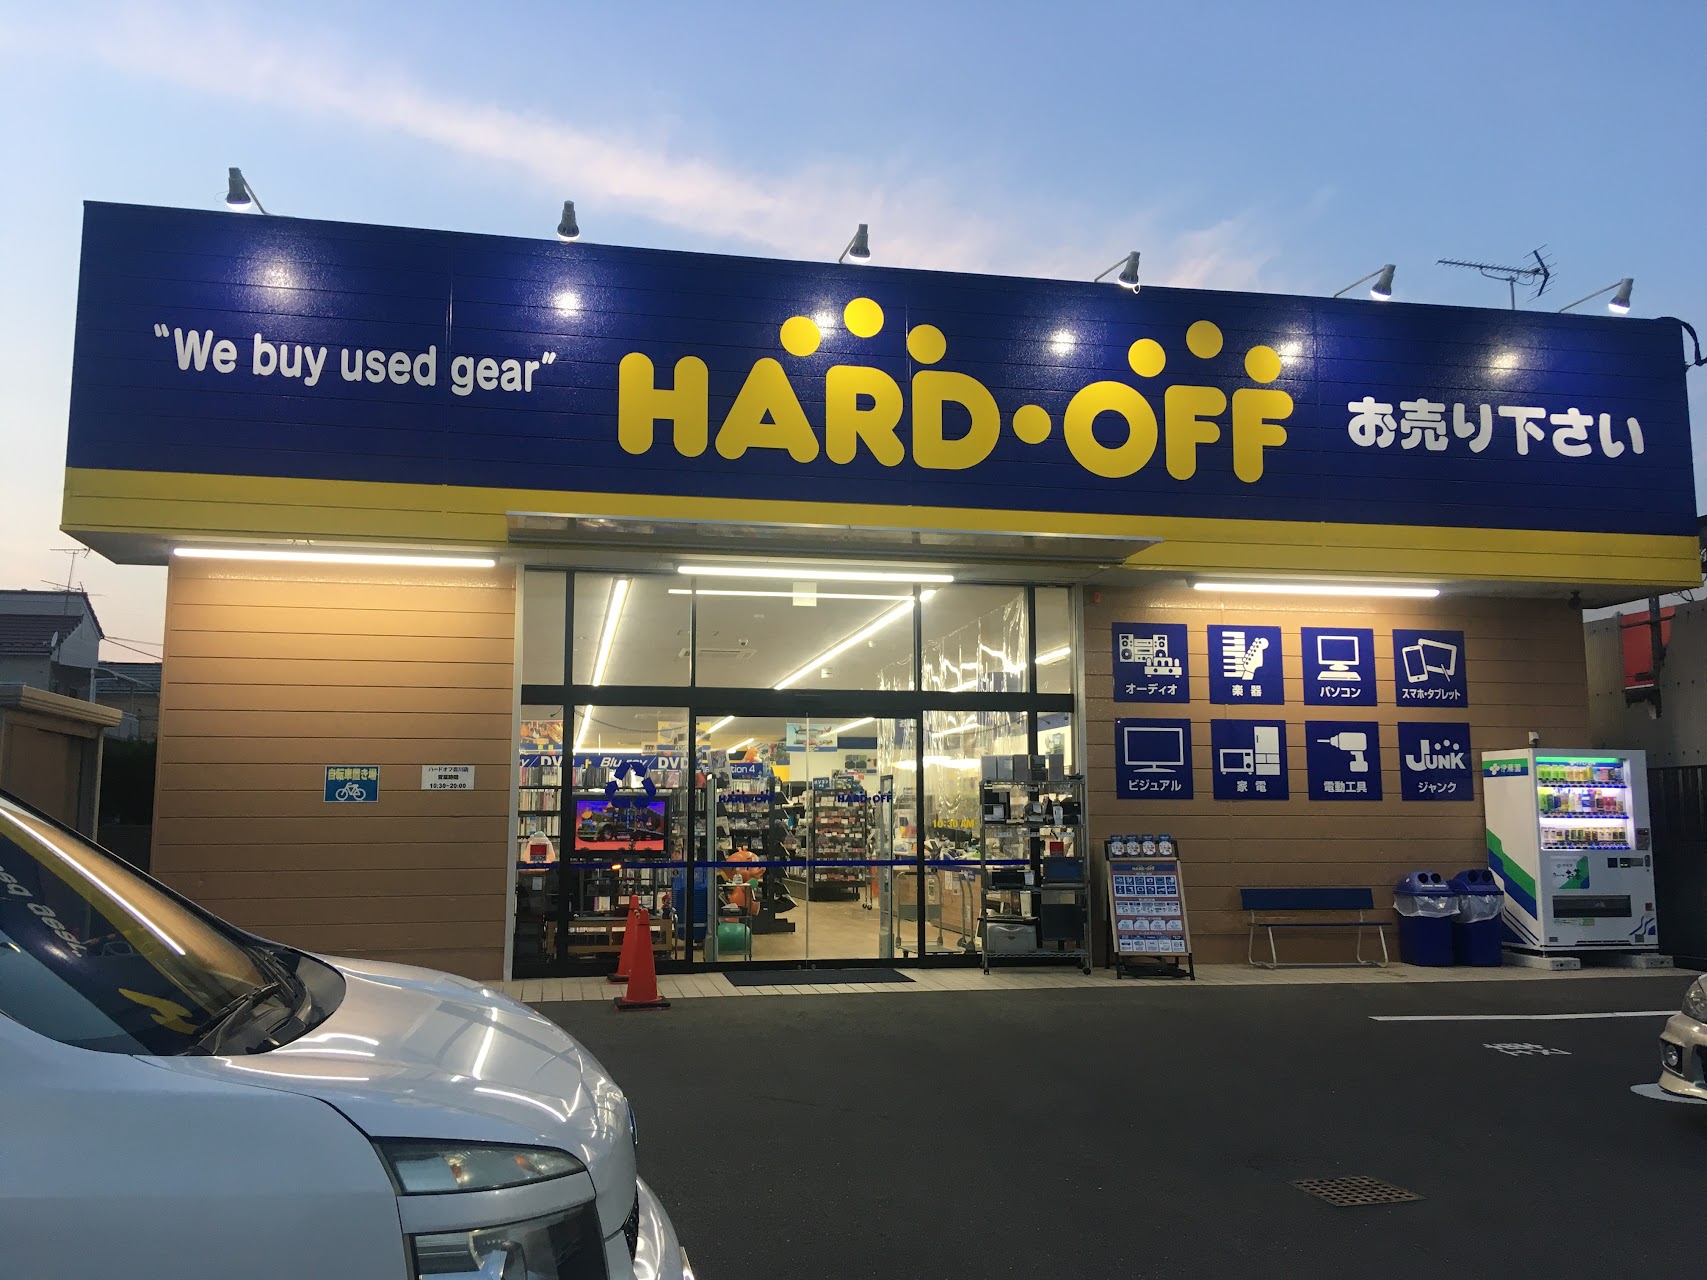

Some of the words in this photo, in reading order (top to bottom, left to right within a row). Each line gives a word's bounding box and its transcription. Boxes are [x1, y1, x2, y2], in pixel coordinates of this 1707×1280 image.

[252, 333, 328, 387] buy
[340, 345, 437, 386] used
[1347, 396, 1645, 458] お売り下さい
[1125, 683, 1178, 696] オーディオ
[1319, 685, 1362, 698] パソコン
[1405, 739, 1466, 771] JUNK
[1128, 779, 1182, 792] ビジュアル
[1236, 780, 1267, 793] 家電
[1323, 780, 1368, 793] 電動工具
[1418, 781, 1457, 794] ジャンク
[960, 818, 975, 828] AM
